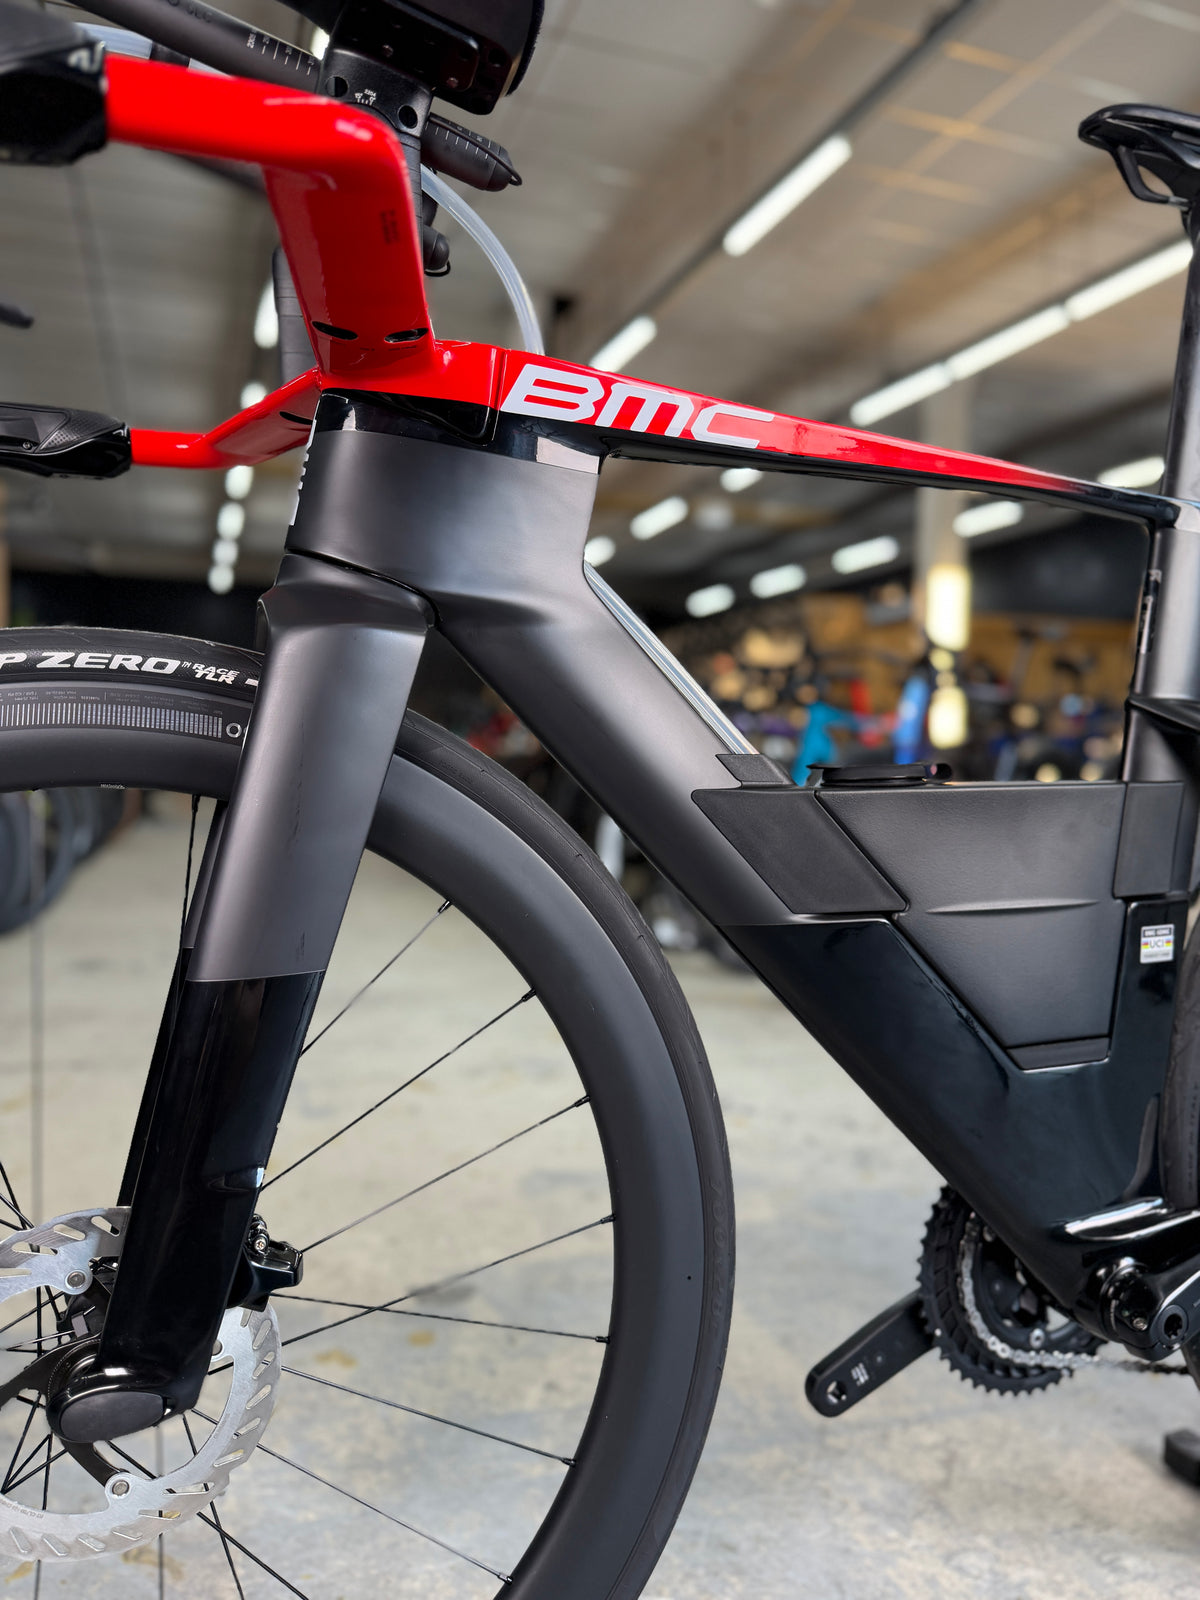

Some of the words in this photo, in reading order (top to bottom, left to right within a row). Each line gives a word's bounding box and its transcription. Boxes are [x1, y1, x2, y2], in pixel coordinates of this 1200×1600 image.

[500, 363, 775, 449] BMC
[36, 651, 181, 675] ZERO
[192, 663, 240, 678] RACE
[194, 669, 236, 685] TLR
[1149, 938, 1165, 949] UCI
